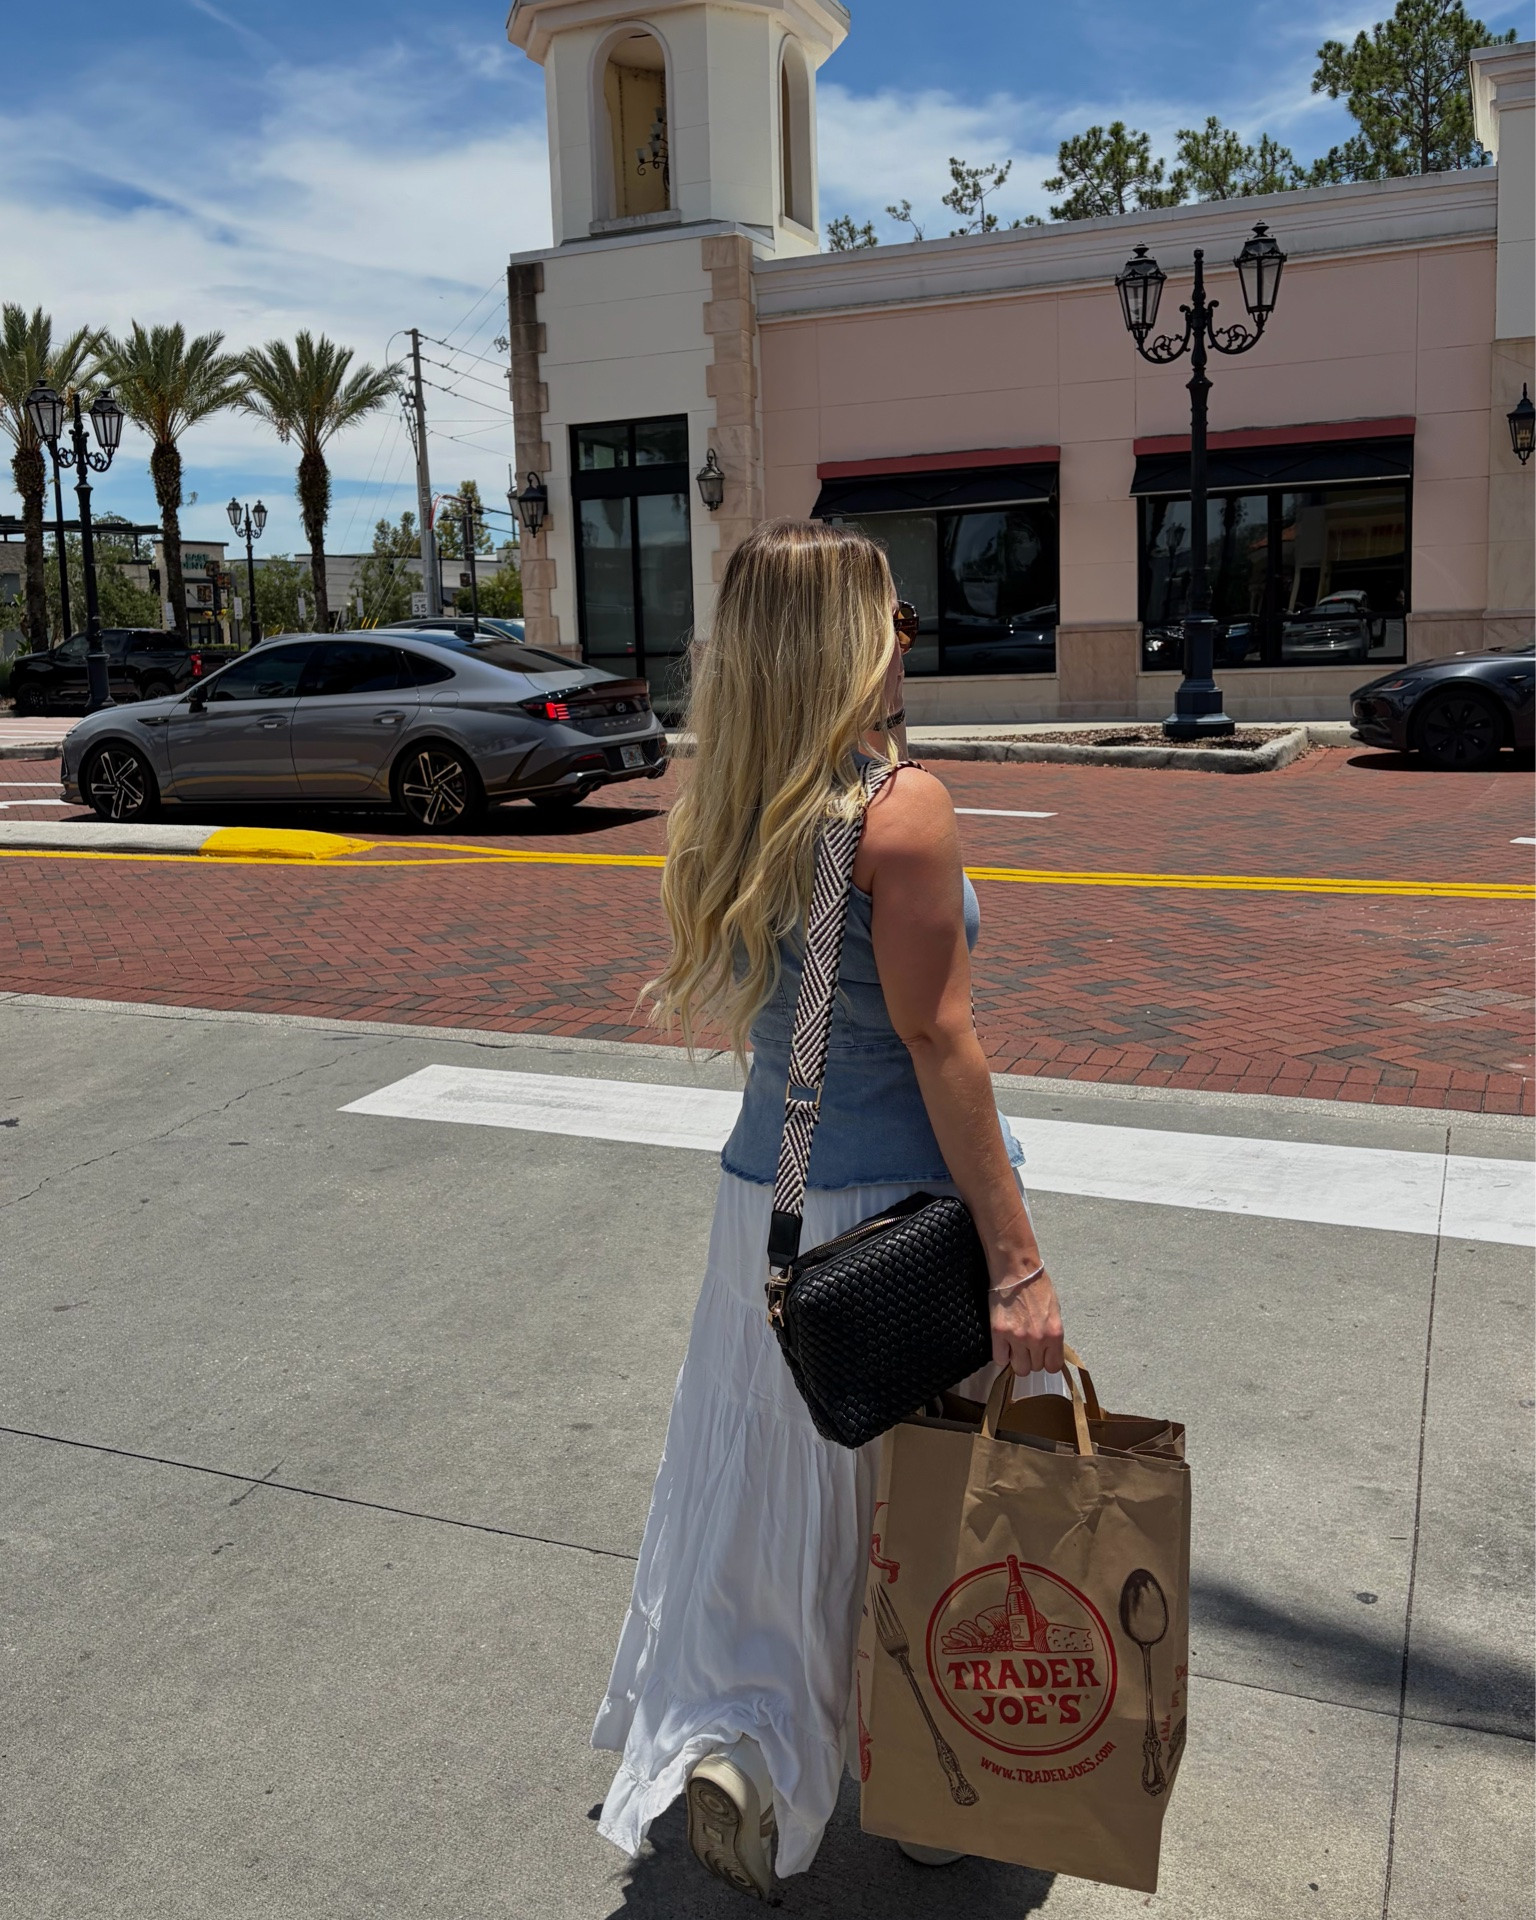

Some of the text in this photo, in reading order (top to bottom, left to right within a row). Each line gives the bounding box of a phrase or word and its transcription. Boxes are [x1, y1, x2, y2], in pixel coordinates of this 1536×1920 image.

[414, 604, 427, 613] 35
[946, 1658, 1101, 1690] TRADER
[972, 1693, 1082, 1726] JOE'S
